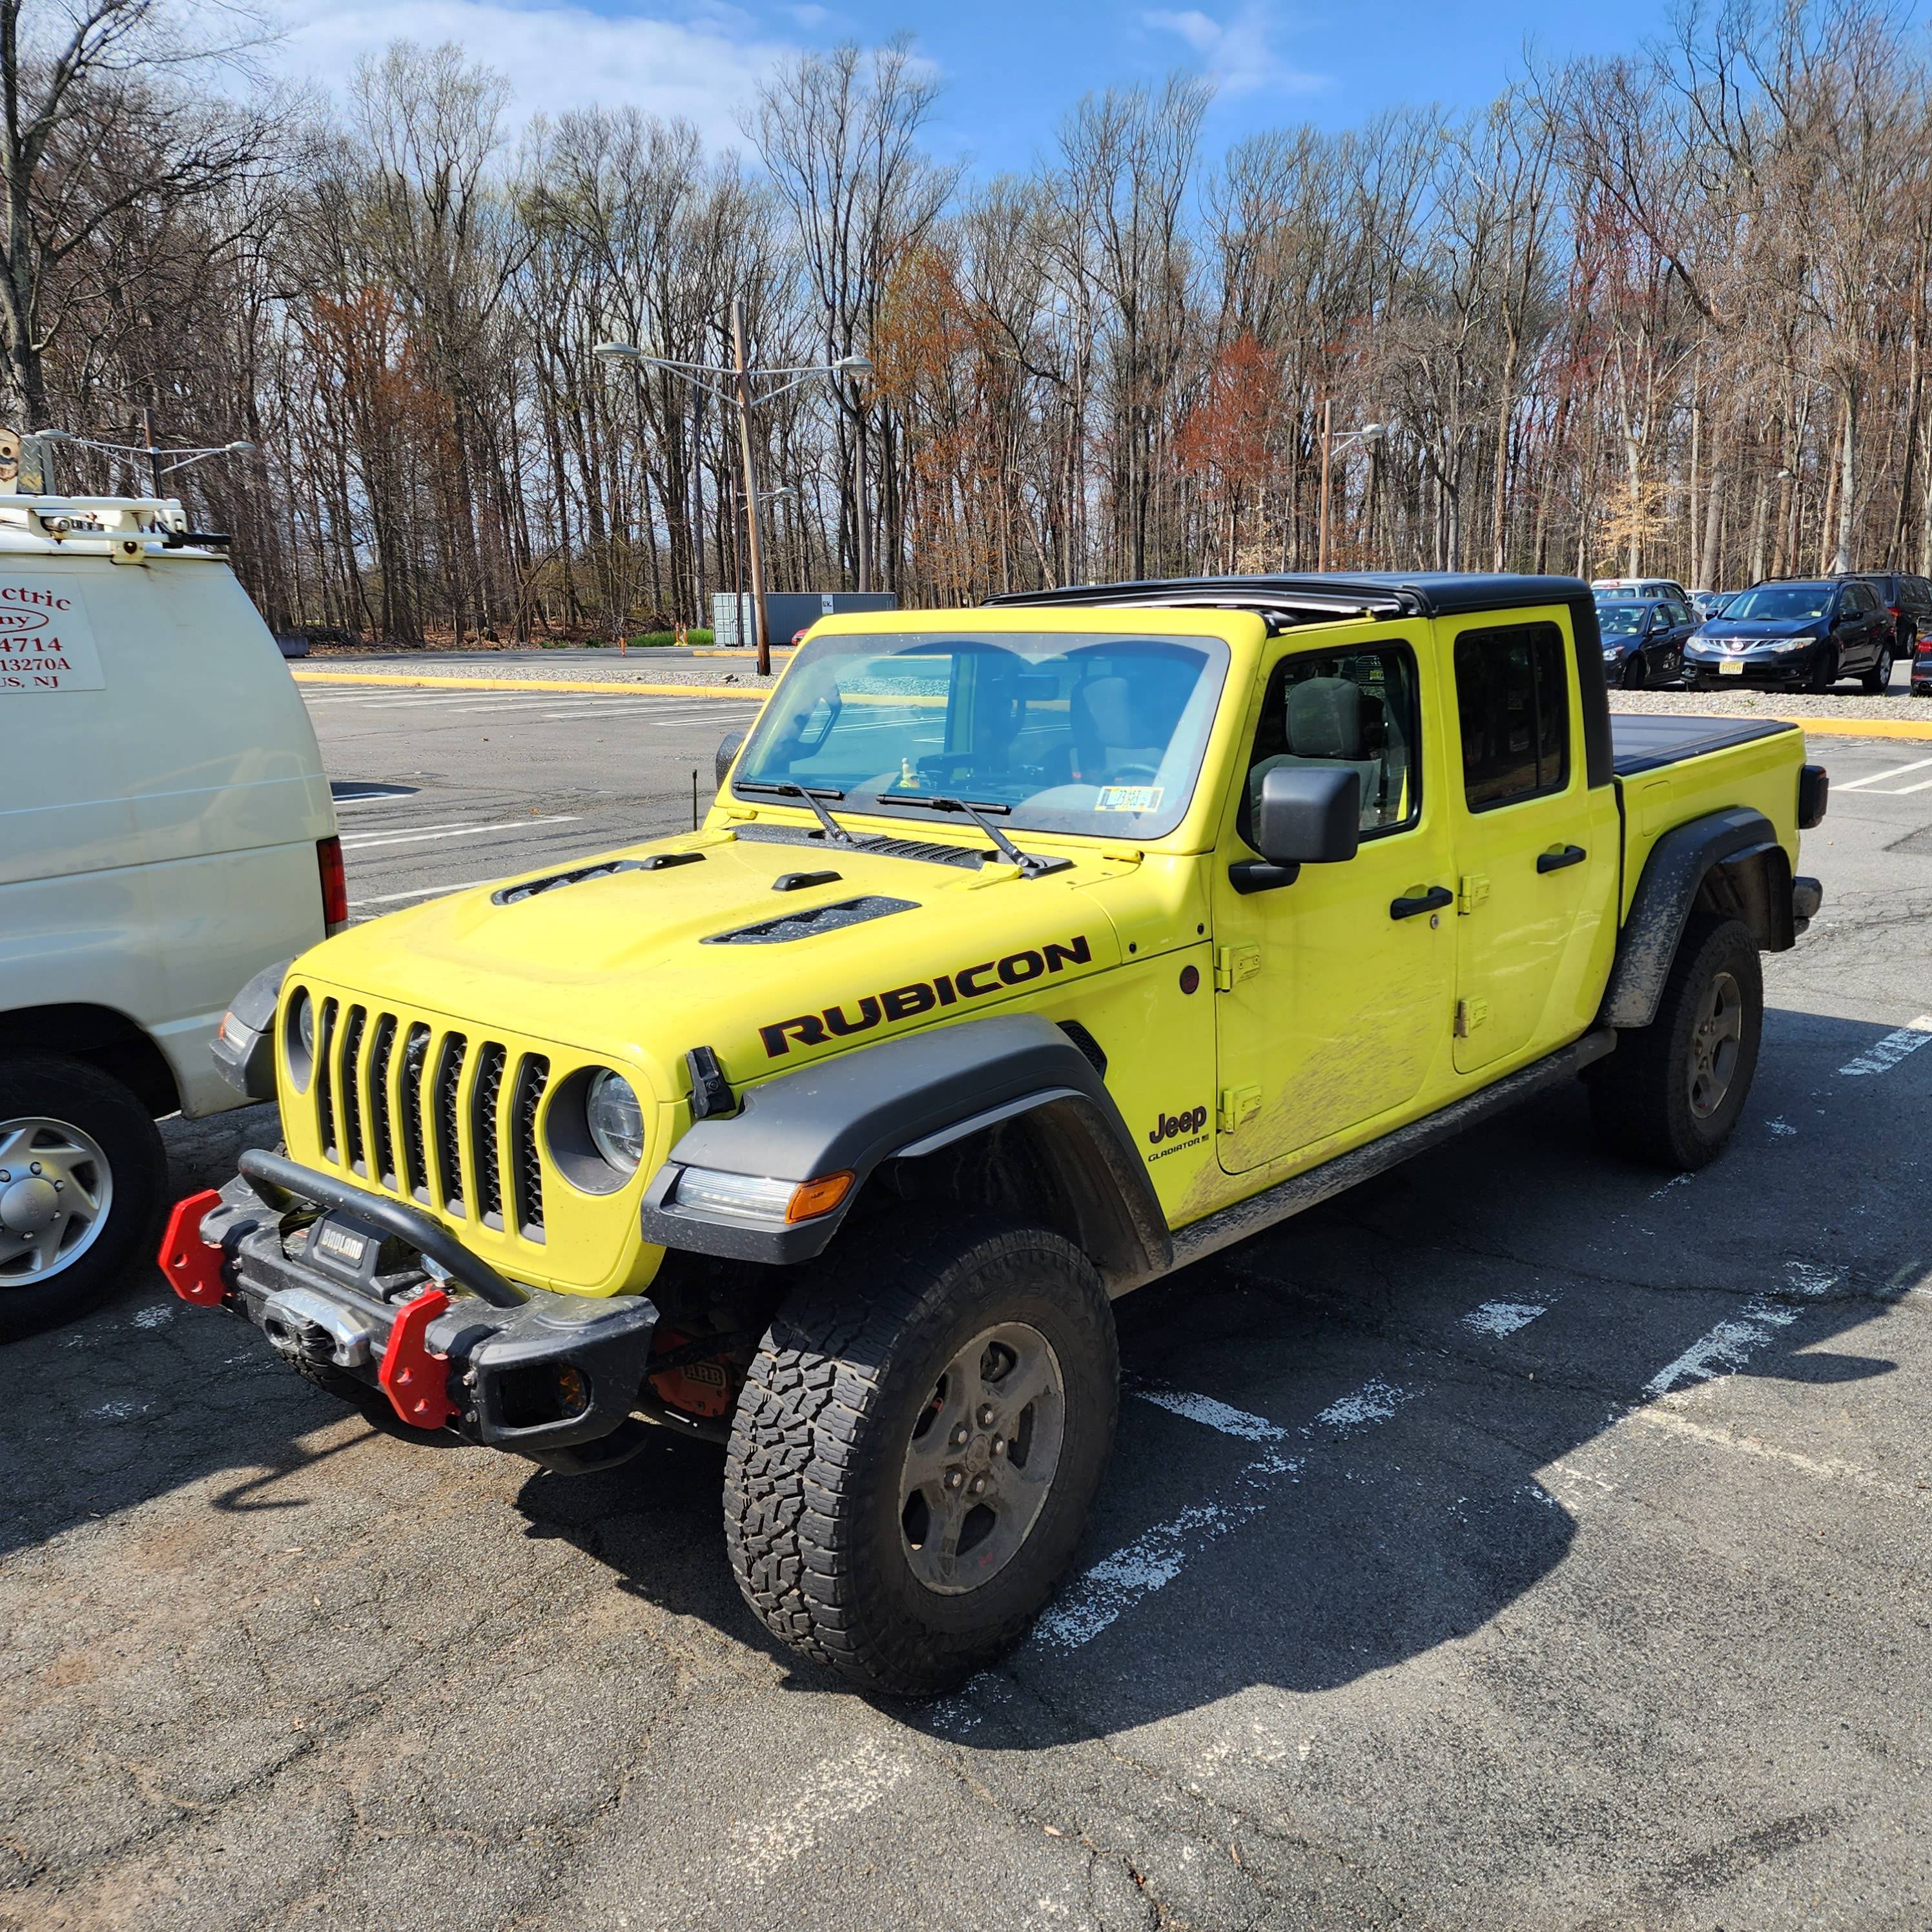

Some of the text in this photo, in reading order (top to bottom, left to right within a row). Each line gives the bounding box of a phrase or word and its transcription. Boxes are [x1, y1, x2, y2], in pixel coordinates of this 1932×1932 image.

[0, 637, 64, 652] 4714
[0, 657, 72, 672] 13270A
[34, 676, 59, 688] NJ
[757, 935, 1093, 1059] RUBICON
[1149, 1105, 1207, 1144] Jeep
[1148, 1137, 1200, 1162] GLADIATOR
[321, 1228, 364, 1260] BADLAND
[686, 1364, 721, 1384] ARB
